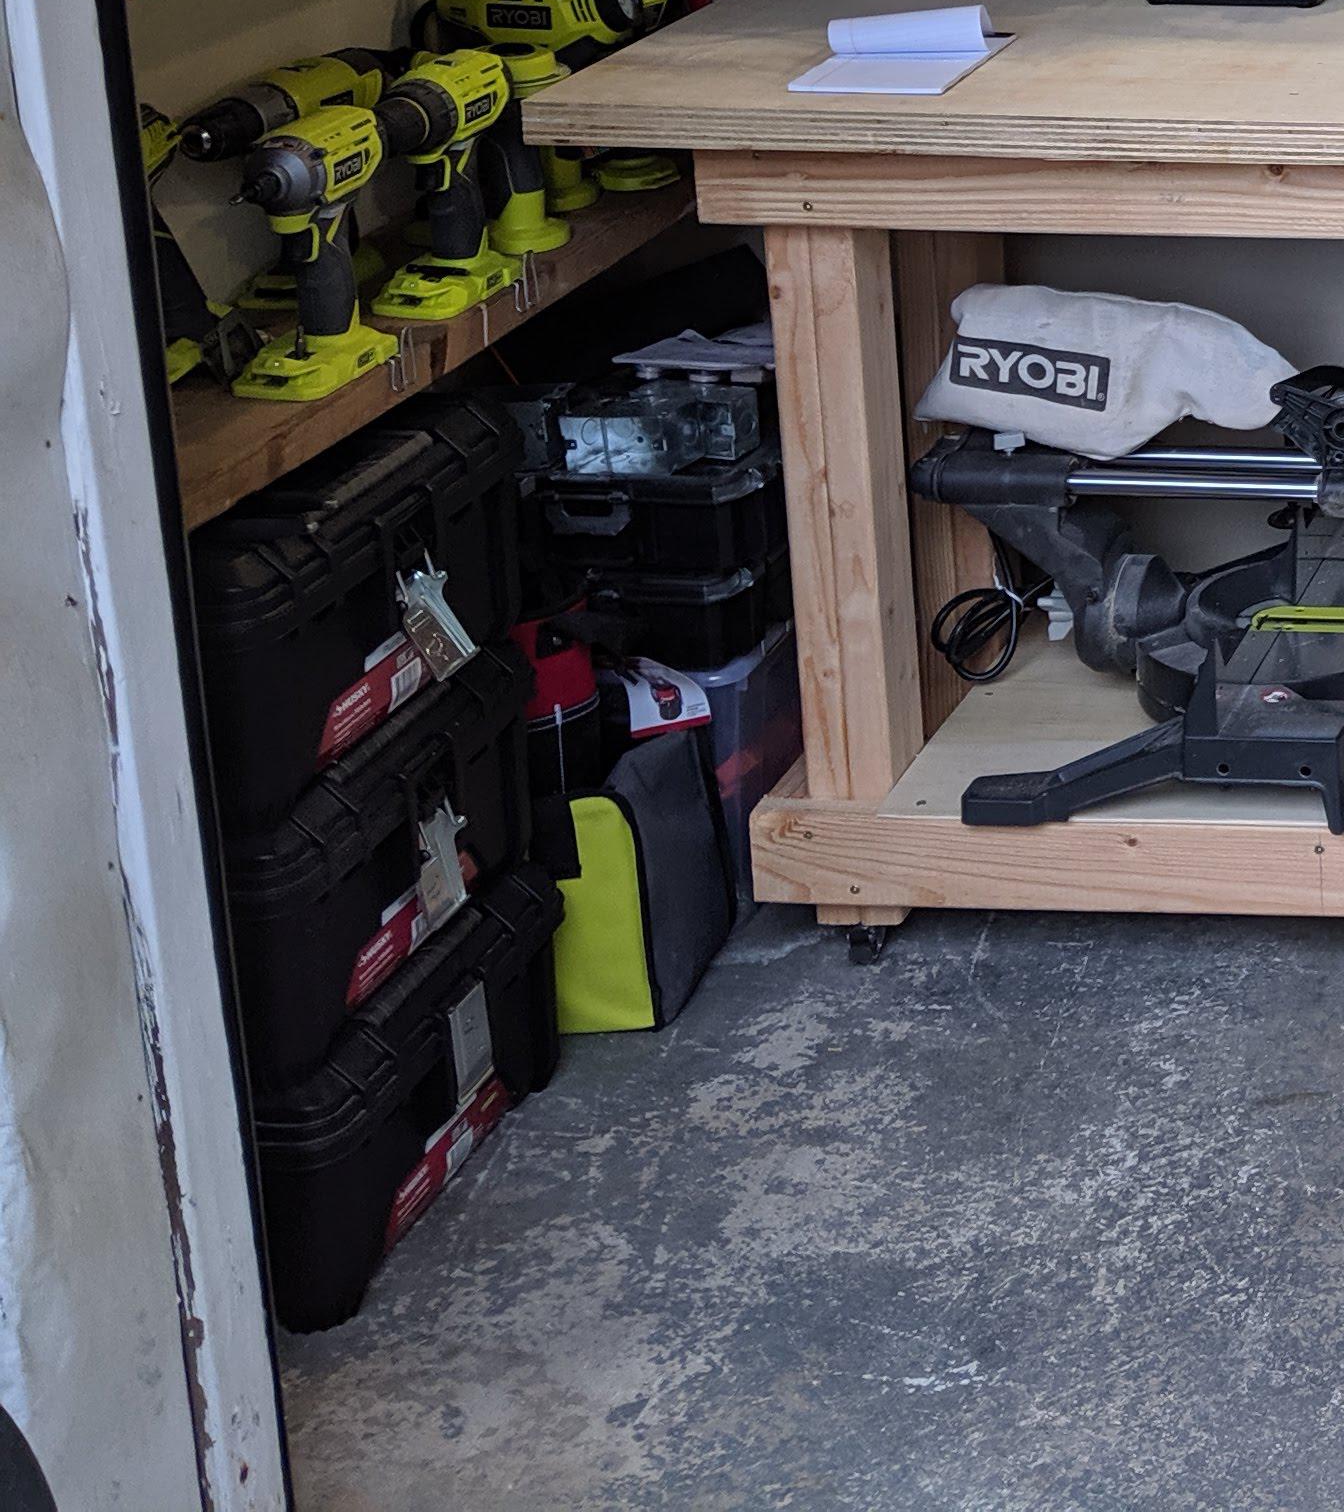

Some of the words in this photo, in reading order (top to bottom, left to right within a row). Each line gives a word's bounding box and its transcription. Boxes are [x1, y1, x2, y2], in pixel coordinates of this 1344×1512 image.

[490, 8, 548, 26] RYOBI
[465, 98, 490, 124] RYOBI
[335, 157, 363, 185] RYOBI
[960, 346, 1105, 402] RYOBI
